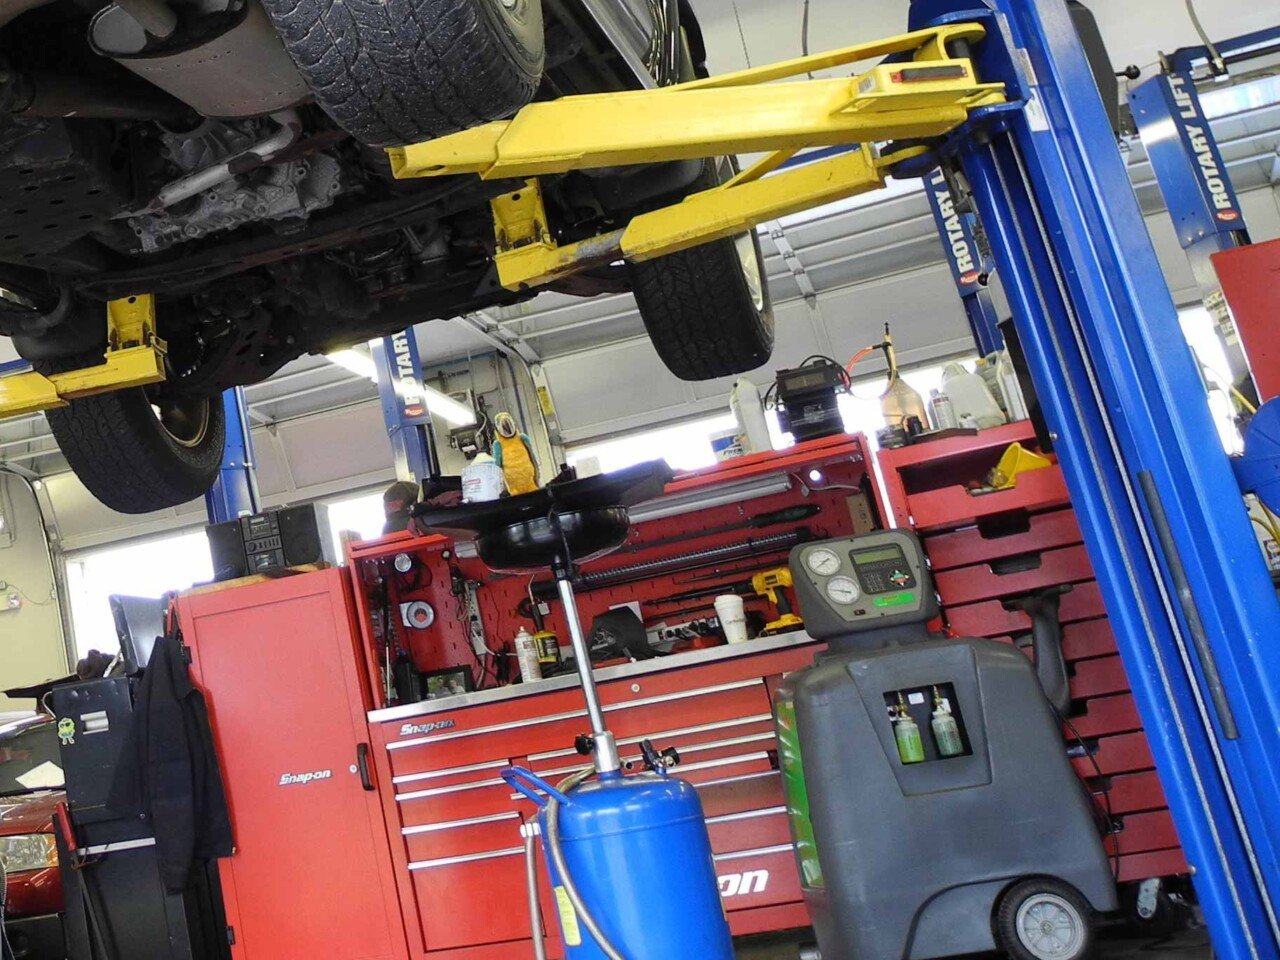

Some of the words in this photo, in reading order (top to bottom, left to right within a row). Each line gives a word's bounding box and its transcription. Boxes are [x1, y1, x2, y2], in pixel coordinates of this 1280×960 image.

[1166, 72, 1198, 119] LIFT
[1184, 123, 1232, 210] ROTARY
[934, 191, 975, 273] ROTARY
[391, 330, 420, 405] ROTARY
[400, 719, 456, 736] Snap-on
[279, 769, 332, 785] Snap-on
